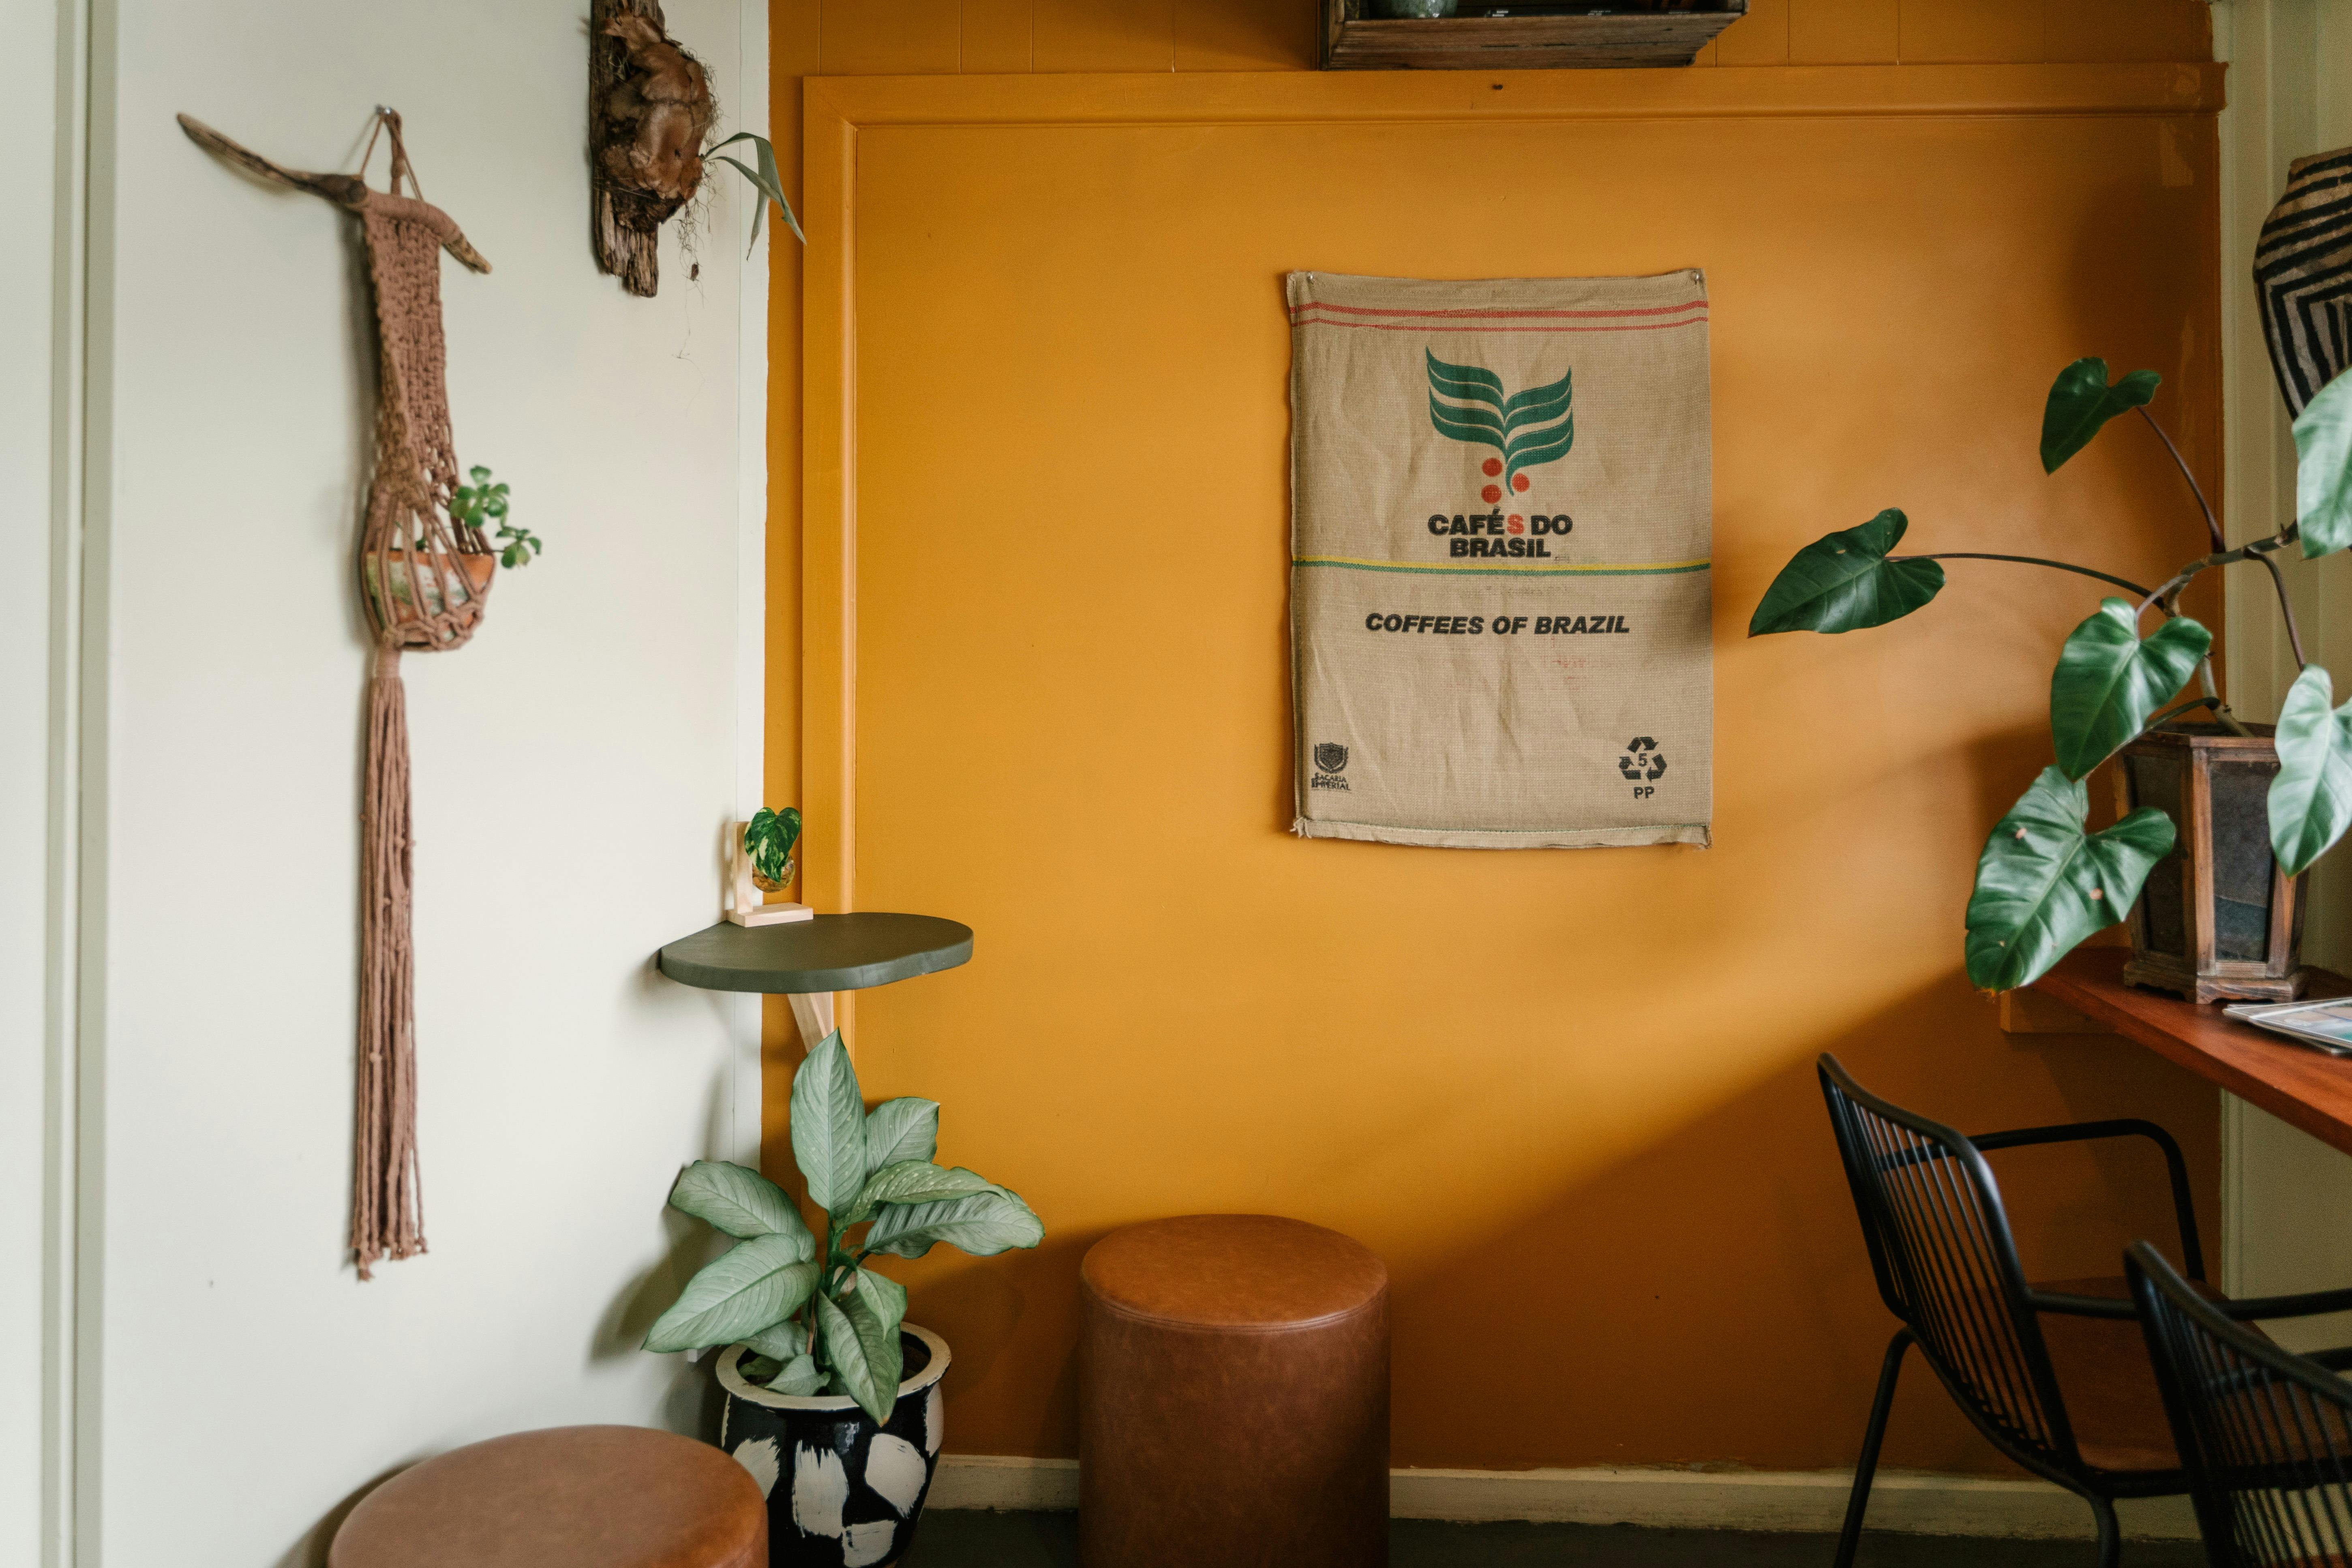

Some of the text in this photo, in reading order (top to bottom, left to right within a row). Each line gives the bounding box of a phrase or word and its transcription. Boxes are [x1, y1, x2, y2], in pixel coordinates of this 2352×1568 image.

[1427, 507, 1573, 536] CAFÉS DO
[1449, 538, 1551, 558] BRASIL
[1366, 613, 1630, 635] COFFEES OF BRAZIL
[1639, 753, 1647, 767] 5
[1634, 786, 1655, 799] PP
